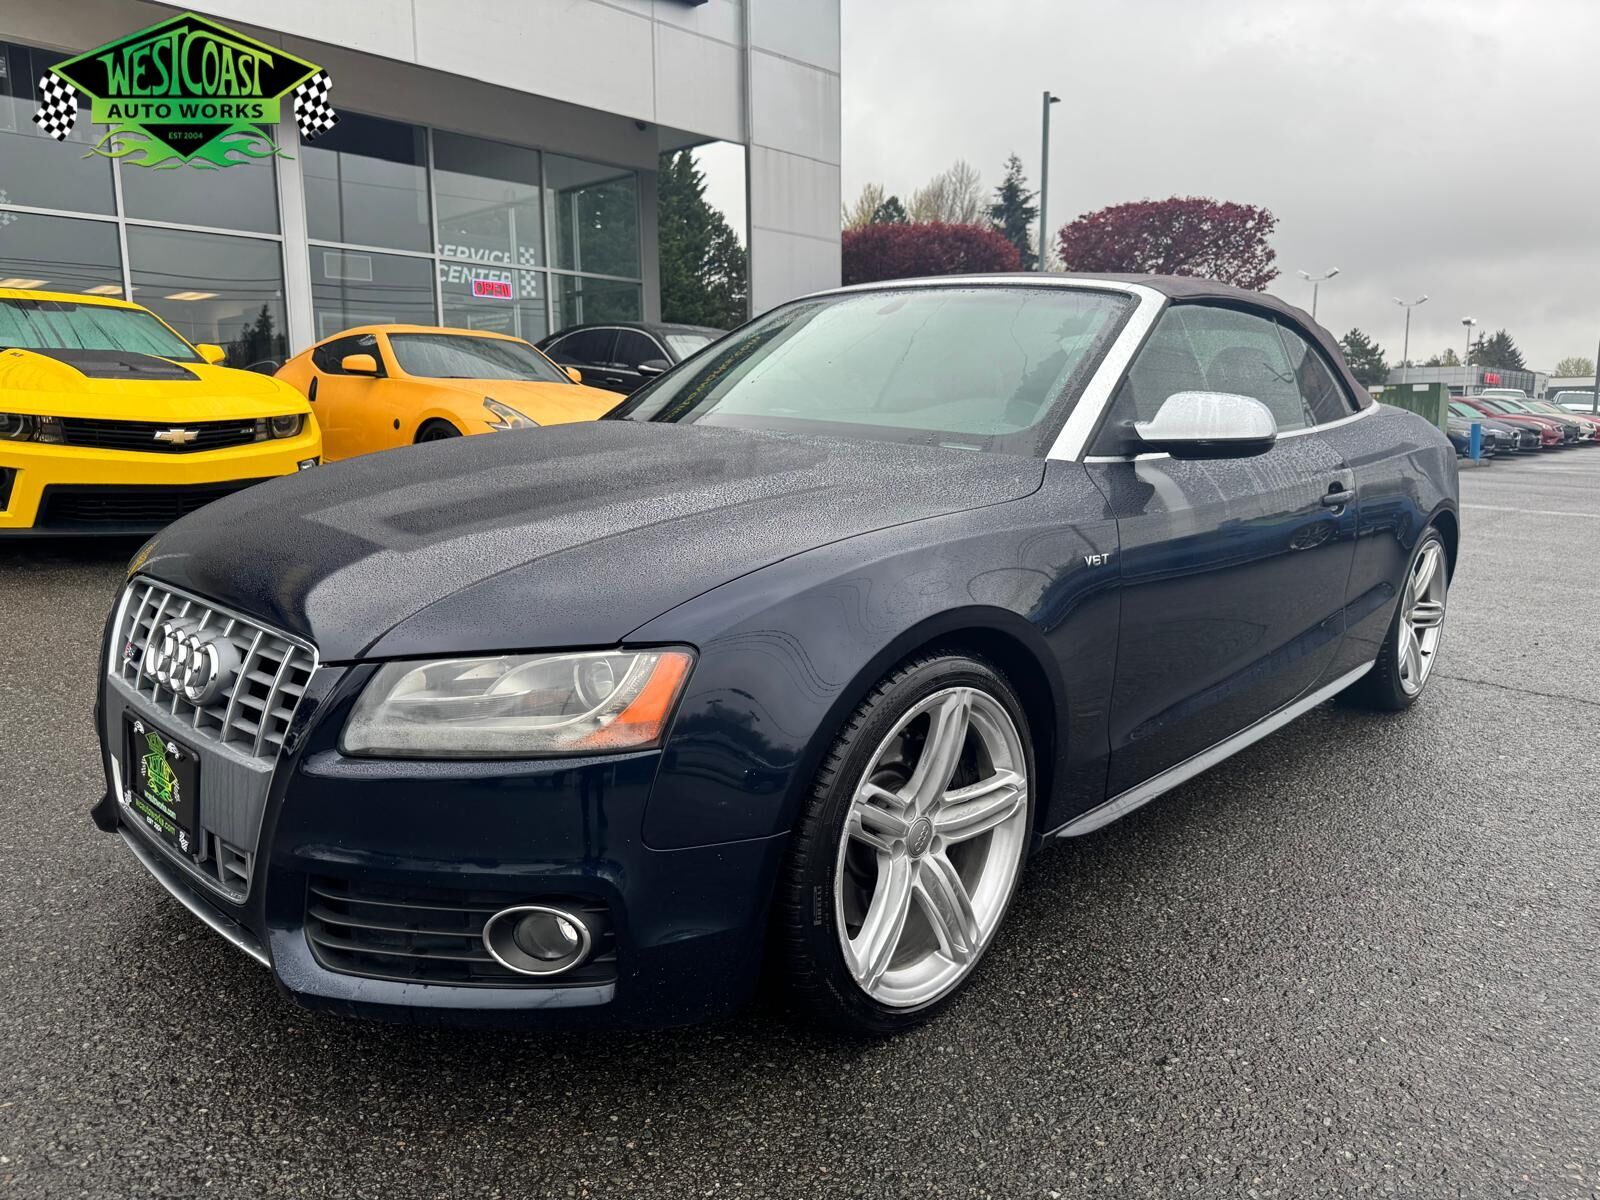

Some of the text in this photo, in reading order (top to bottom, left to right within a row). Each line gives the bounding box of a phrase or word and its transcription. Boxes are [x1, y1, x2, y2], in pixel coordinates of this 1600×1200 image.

[437, 244, 511, 264] ERVICE
[474, 282, 511, 297] OPEN
[1084, 553, 1110, 567] V6T
